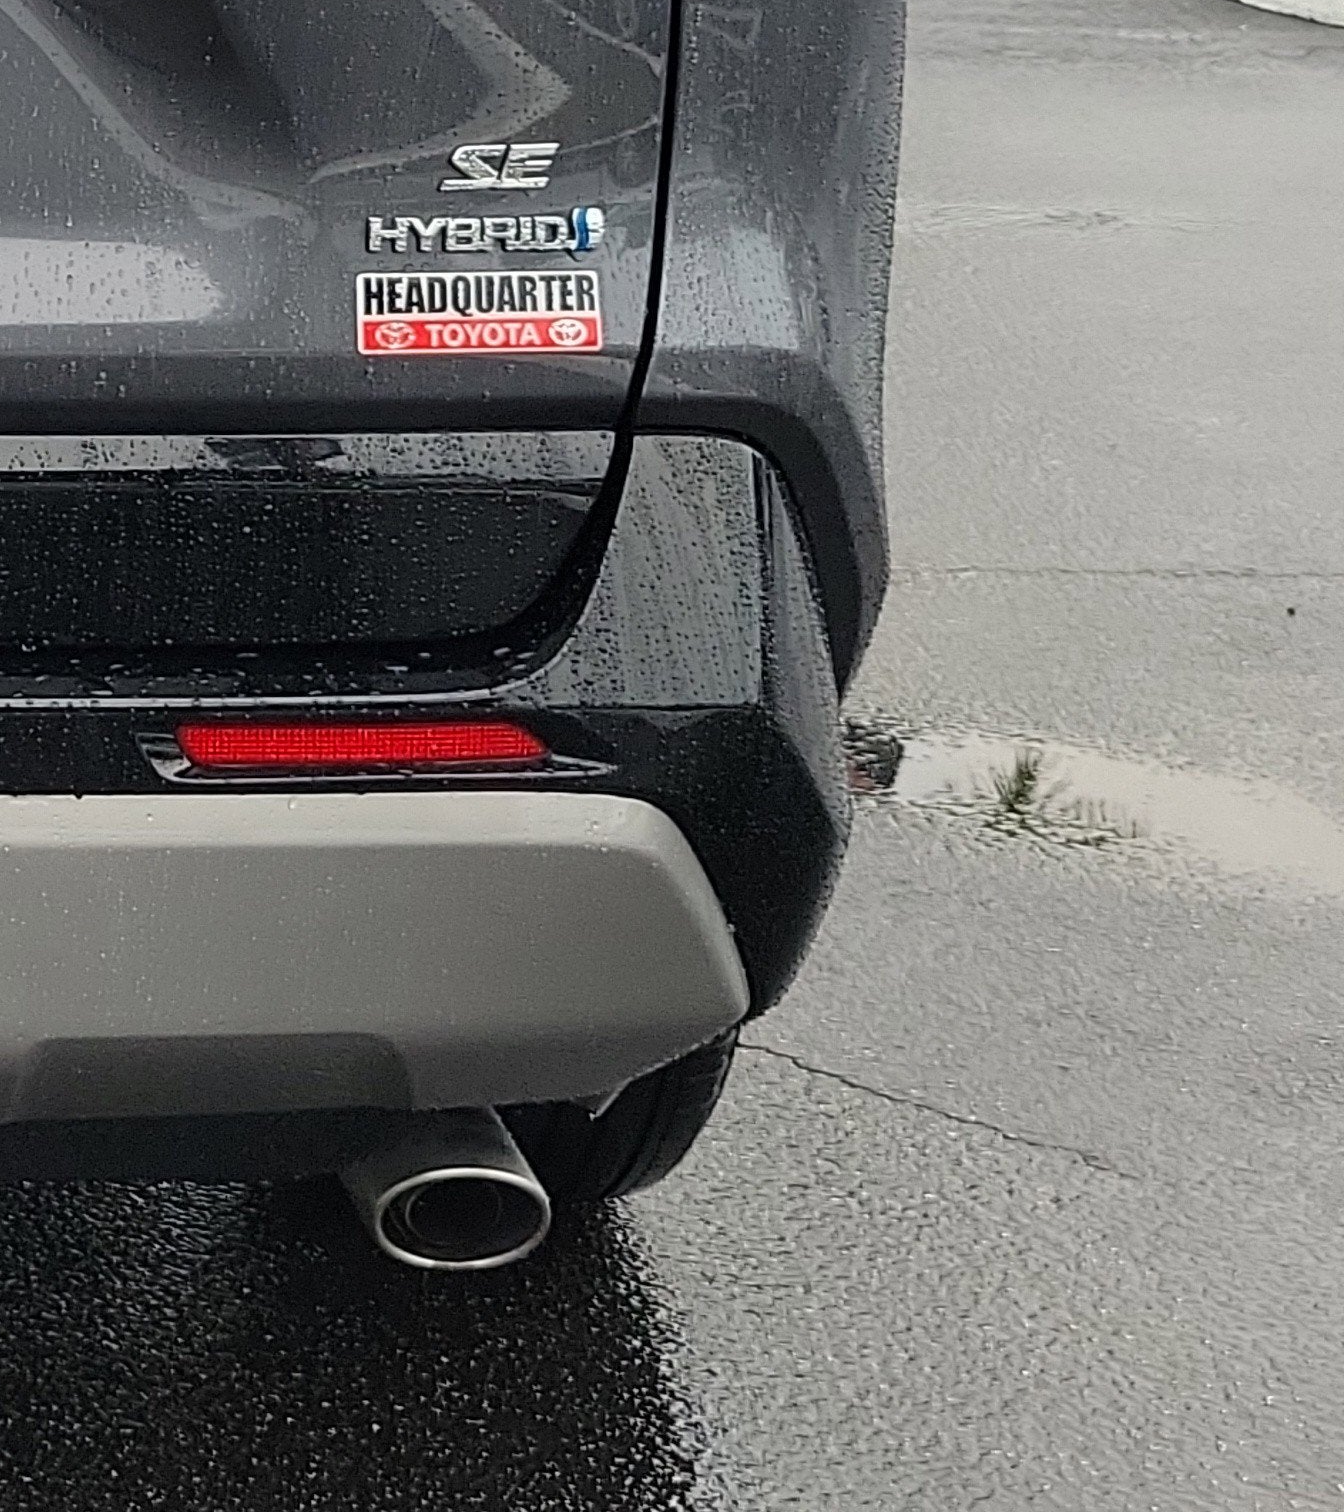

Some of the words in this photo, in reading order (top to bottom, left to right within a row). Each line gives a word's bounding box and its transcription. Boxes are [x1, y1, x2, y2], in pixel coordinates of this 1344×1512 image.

[438, 142, 561, 191] SE
[366, 215, 576, 253] HYBRID
[363, 274, 597, 316] HEADQUARTER
[425, 322, 543, 347] TOYOTA
